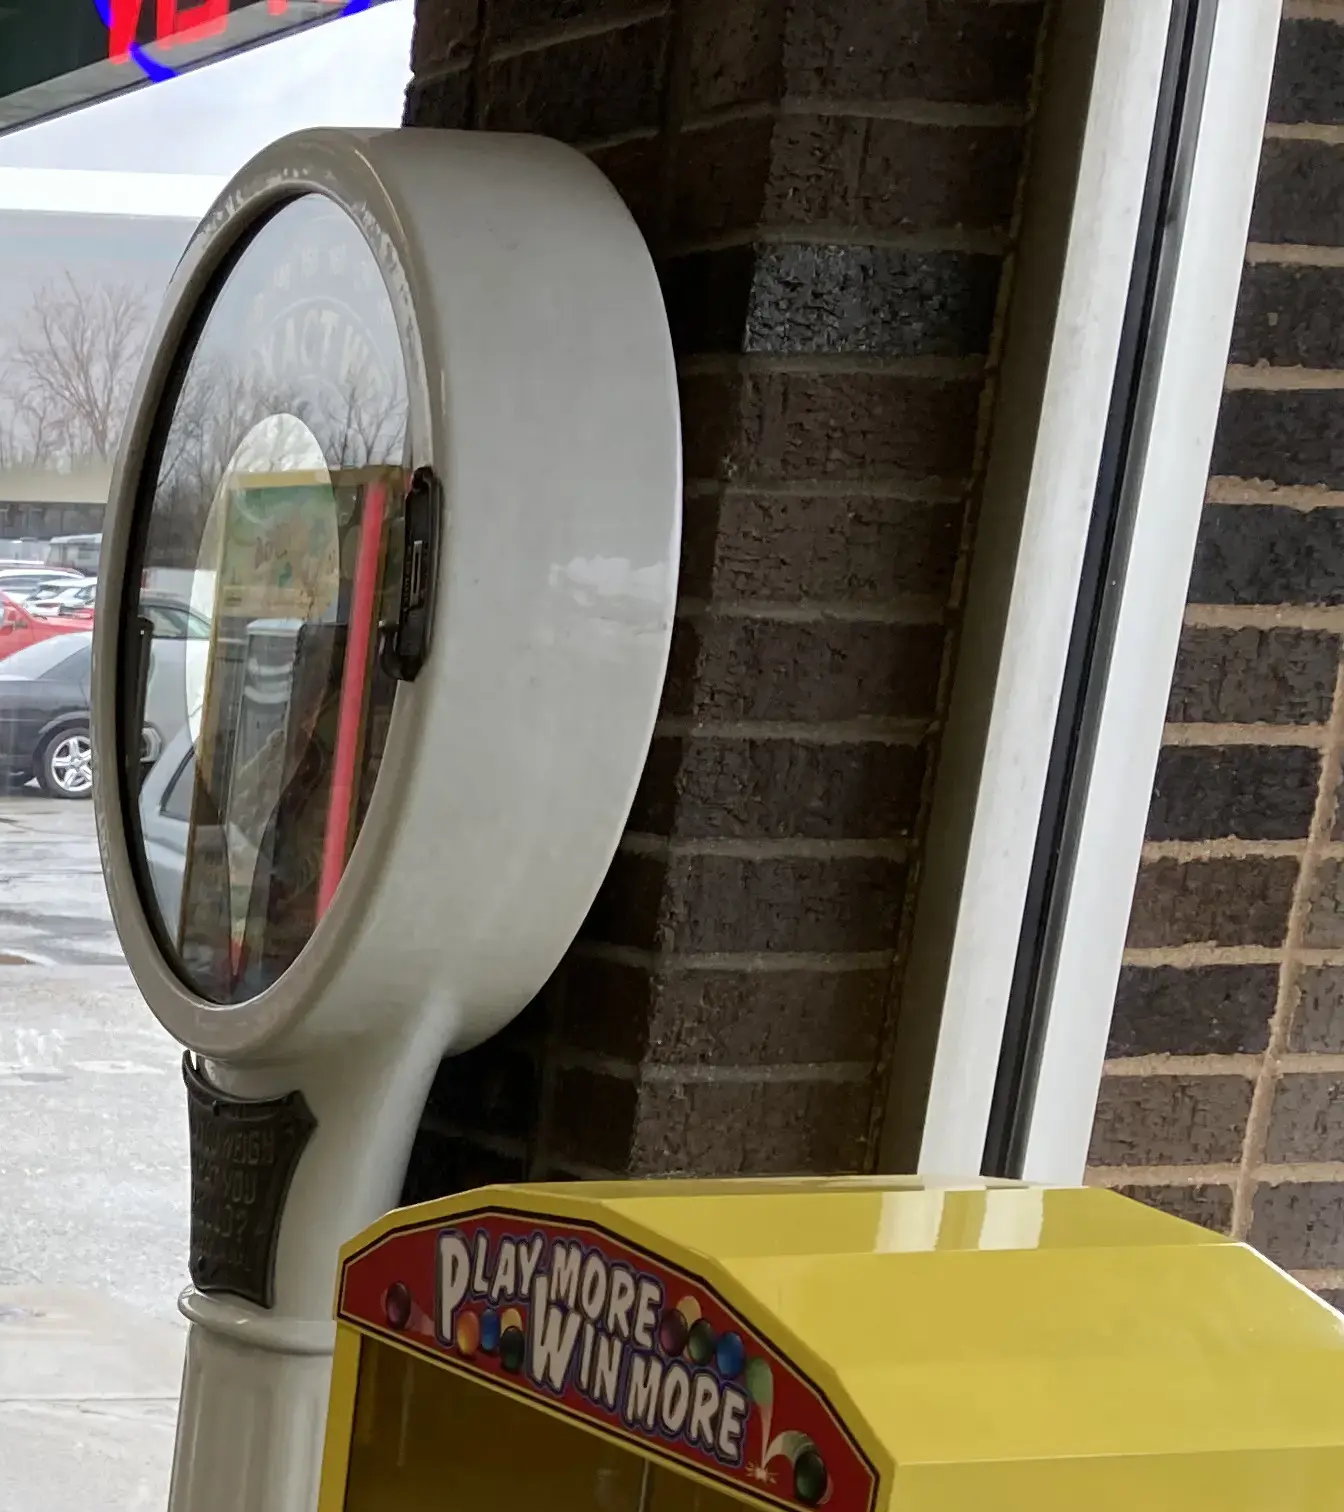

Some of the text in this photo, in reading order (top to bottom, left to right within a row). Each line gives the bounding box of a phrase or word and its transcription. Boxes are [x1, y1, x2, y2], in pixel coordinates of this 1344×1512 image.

[435, 1228, 665, 1352] PLAY MORE
[525, 1273, 750, 1468] WIN MORE
